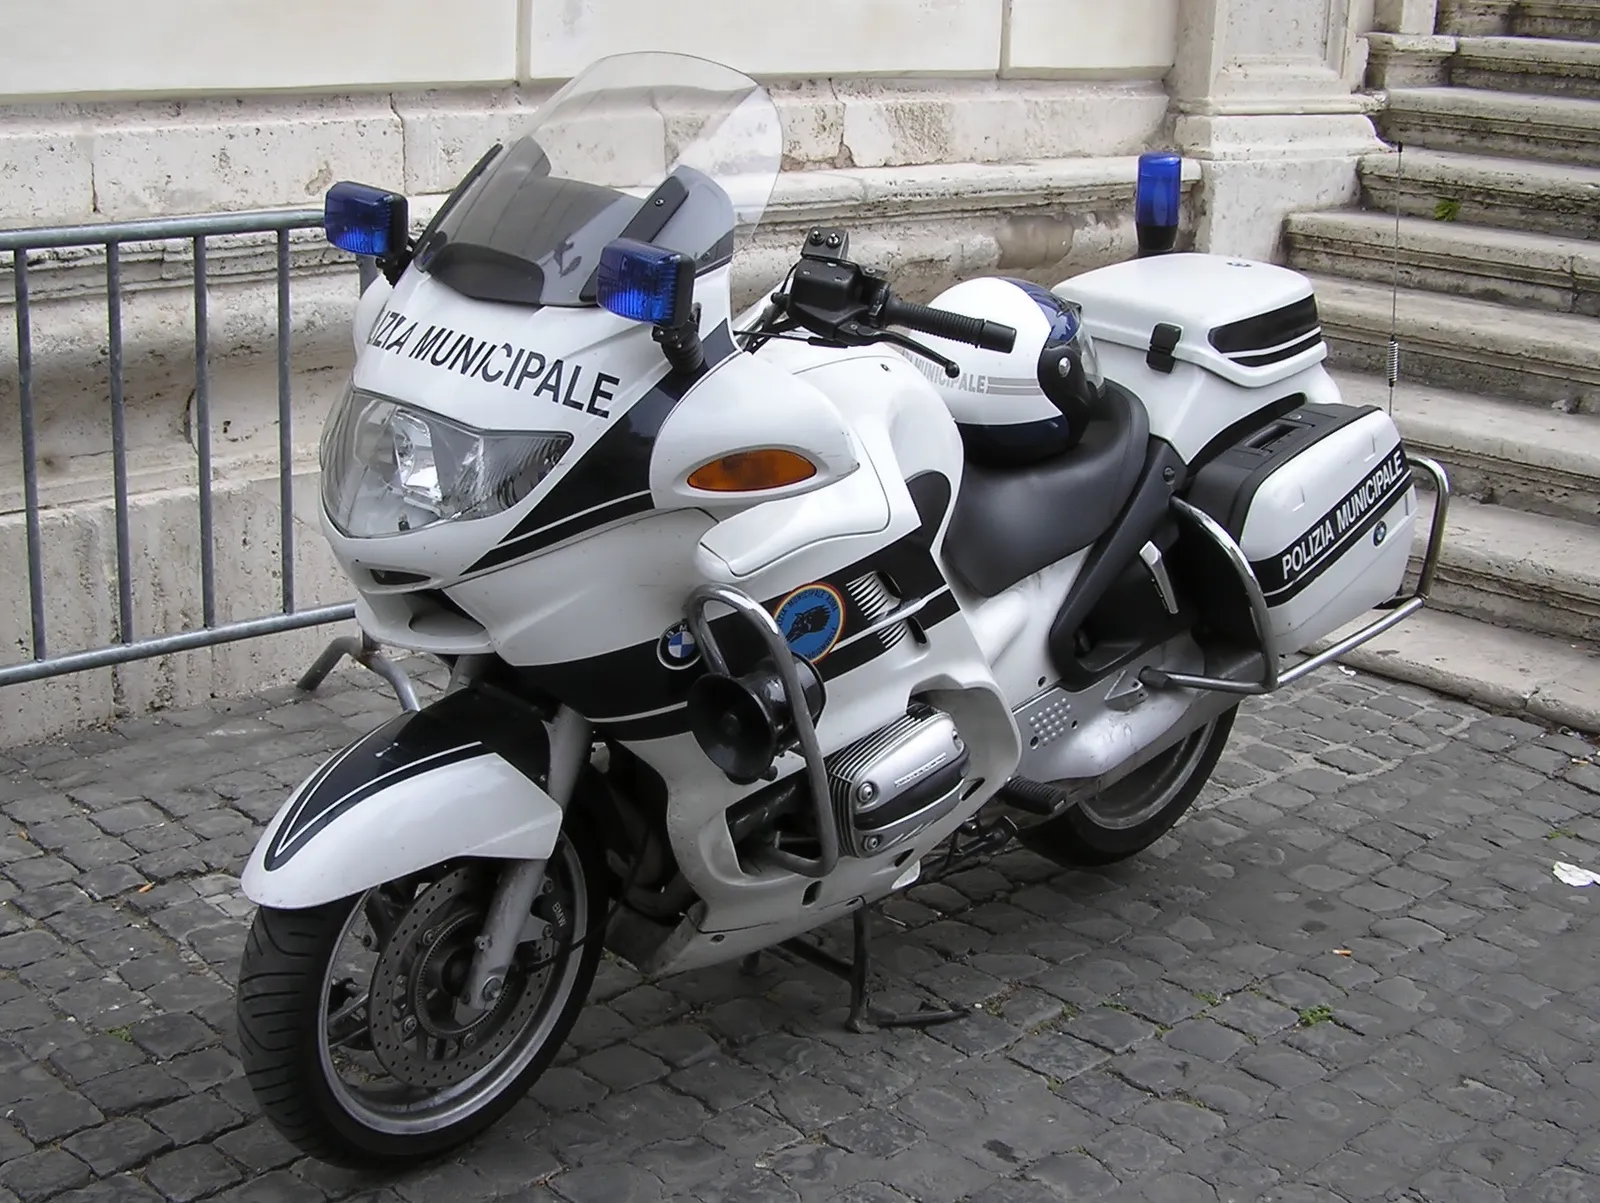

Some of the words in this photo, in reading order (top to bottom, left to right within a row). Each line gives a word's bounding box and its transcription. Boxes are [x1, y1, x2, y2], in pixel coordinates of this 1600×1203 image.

[409, 325, 621, 419] MUNICIPALE
[1282, 519, 1335, 580] POLIZIA
[1336, 450, 1403, 533] MUNICIPALE
[552, 901, 567, 927] BMW
